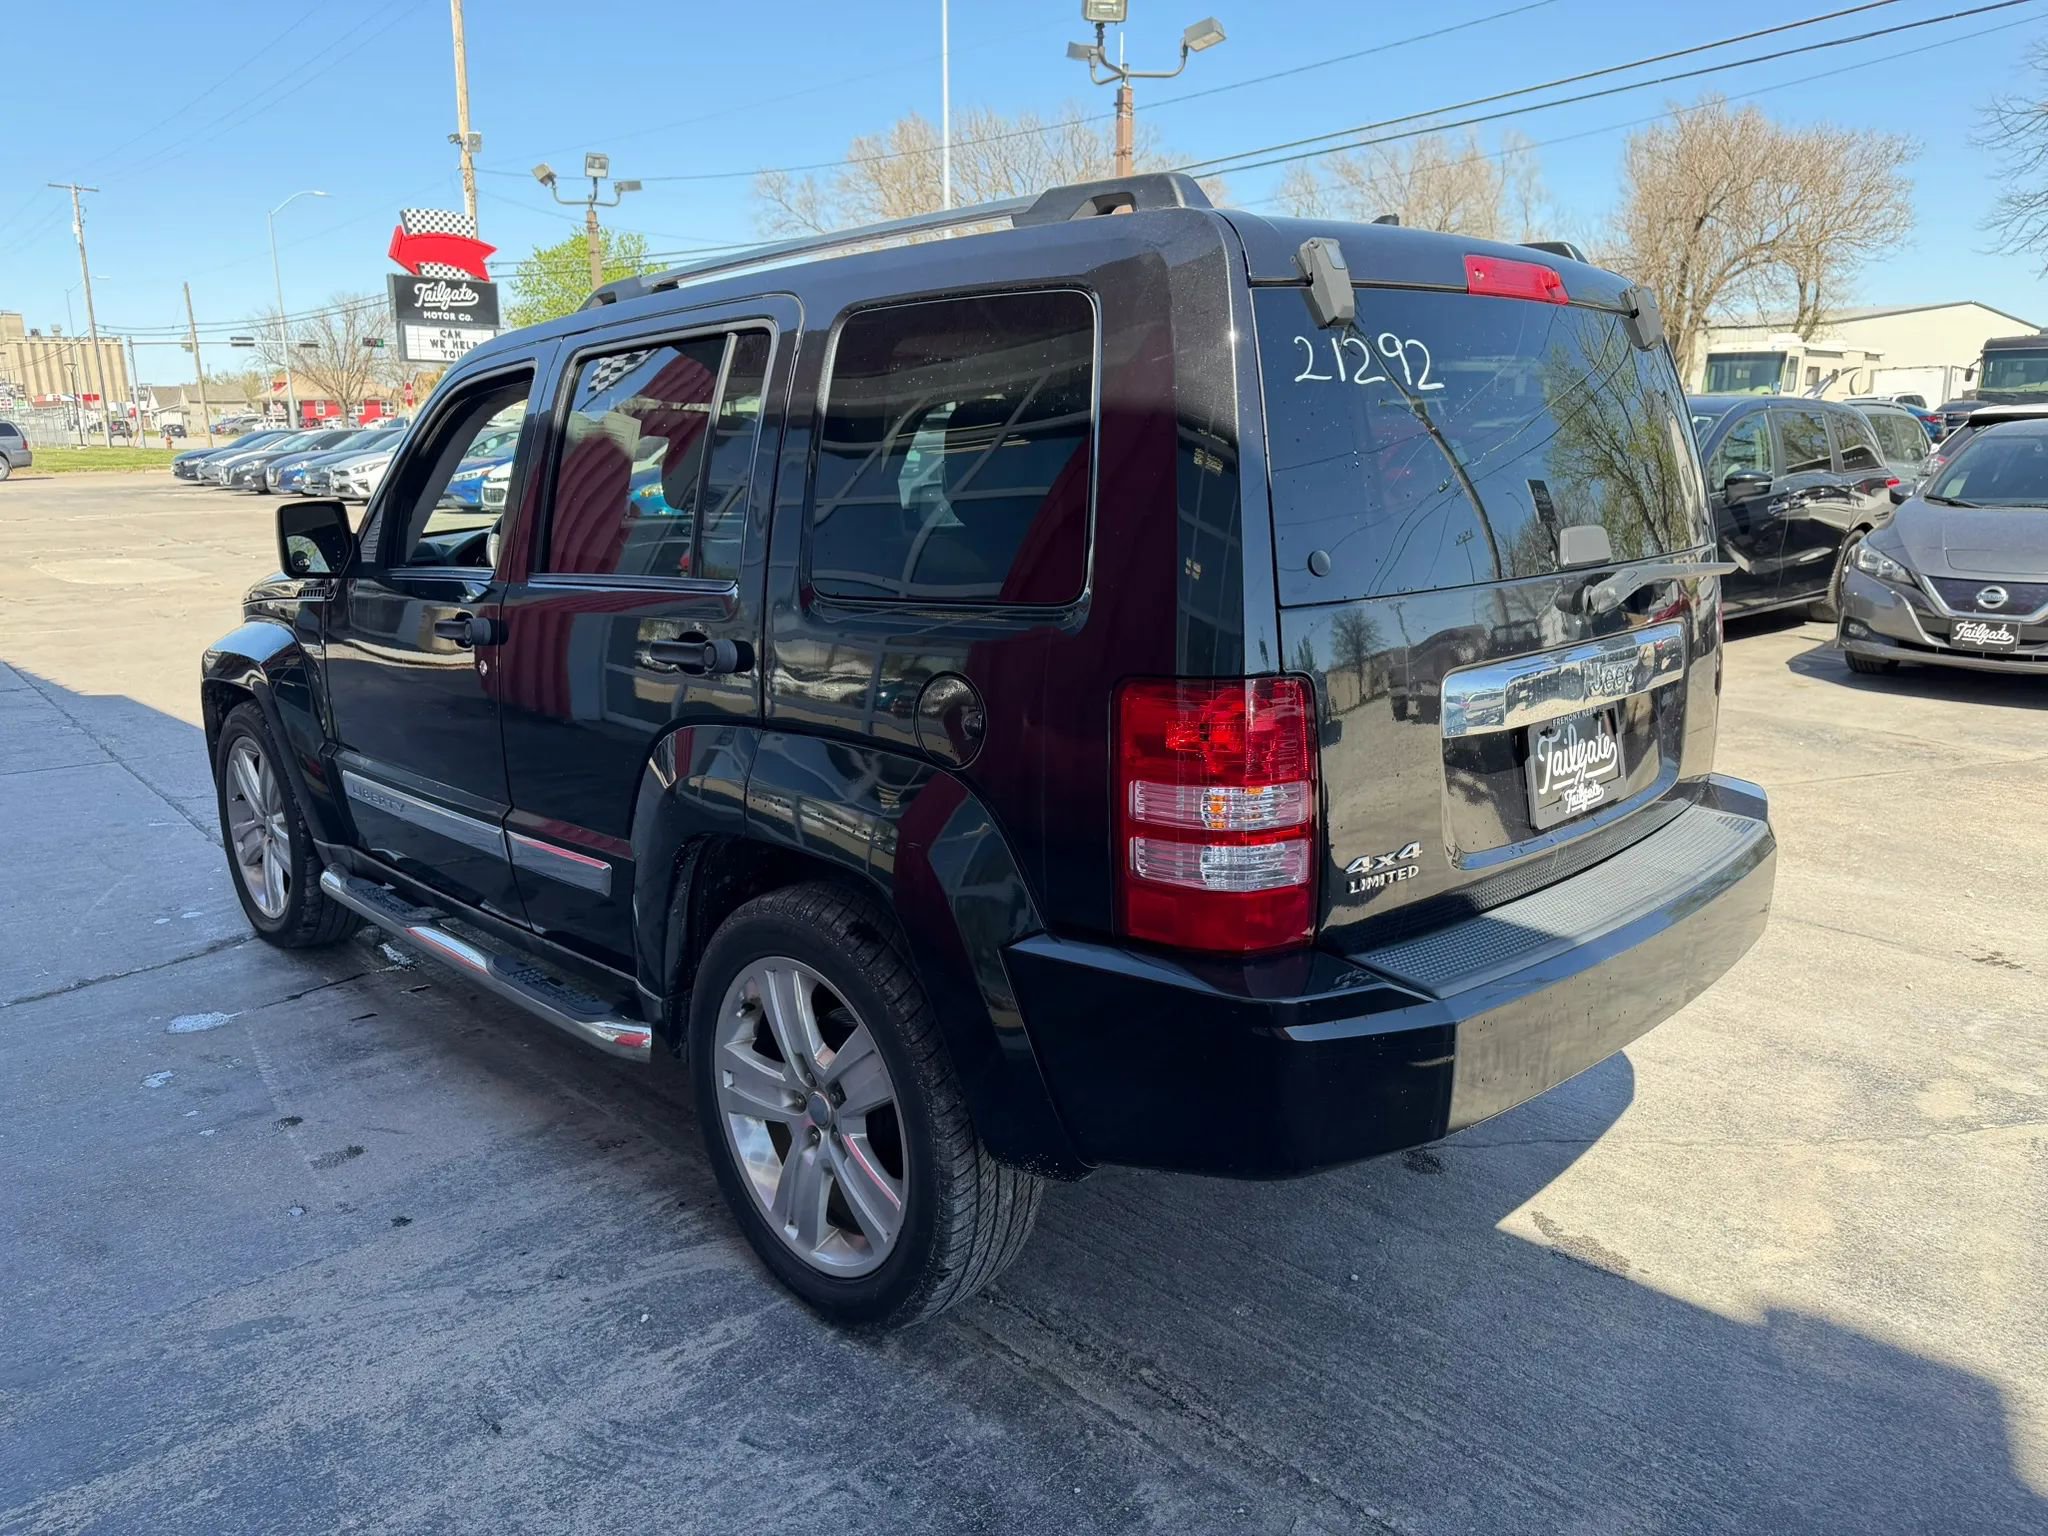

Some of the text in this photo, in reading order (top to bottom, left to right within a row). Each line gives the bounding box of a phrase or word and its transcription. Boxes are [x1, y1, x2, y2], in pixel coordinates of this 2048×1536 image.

[414, 281, 479, 310] Tailgate
[423, 311, 473, 321] MOTOR CO.
[430, 339, 446, 348] WE
[440, 329, 461, 339] CAN
[1294, 332, 1445, 390] 21292
[1953, 621, 2015, 645] Tailgate
[1588, 661, 1636, 696] Jeep
[1552, 710, 1580, 727] FREMONT
[1537, 720, 1618, 795] Tailgate
[352, 783, 405, 812] LIBERTY
[1564, 779, 1605, 814] Tailgate
[1344, 841, 1423, 874] 4x4
[1348, 865, 1419, 894] LIMITED
